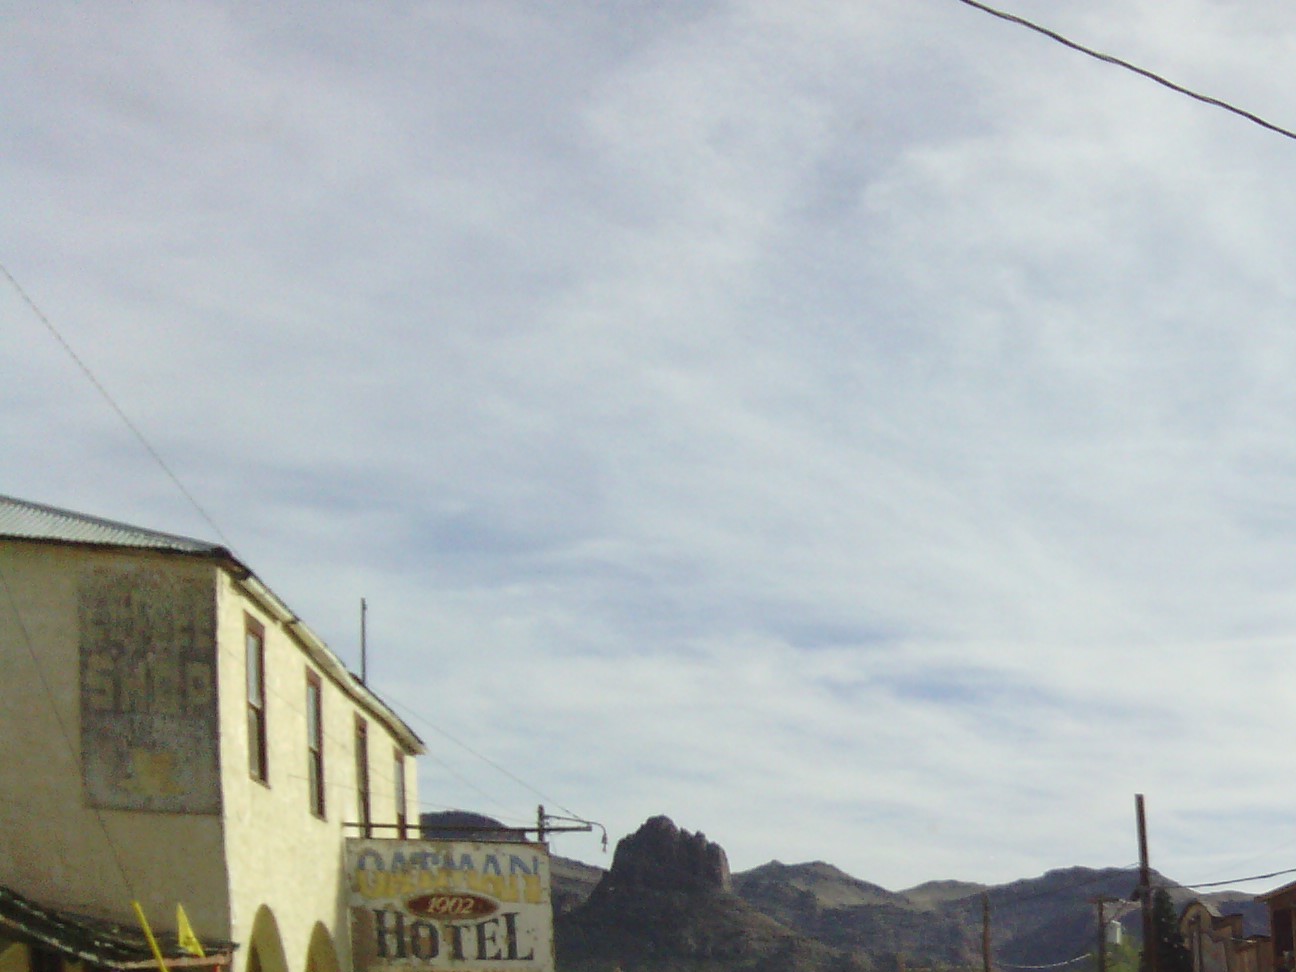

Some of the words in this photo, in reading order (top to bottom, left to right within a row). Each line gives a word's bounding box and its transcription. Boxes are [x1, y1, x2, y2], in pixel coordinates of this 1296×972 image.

[357, 847, 543, 903] OATMAN
[427, 895, 475, 915] 1902
[373, 909, 535, 961] HOTEL
